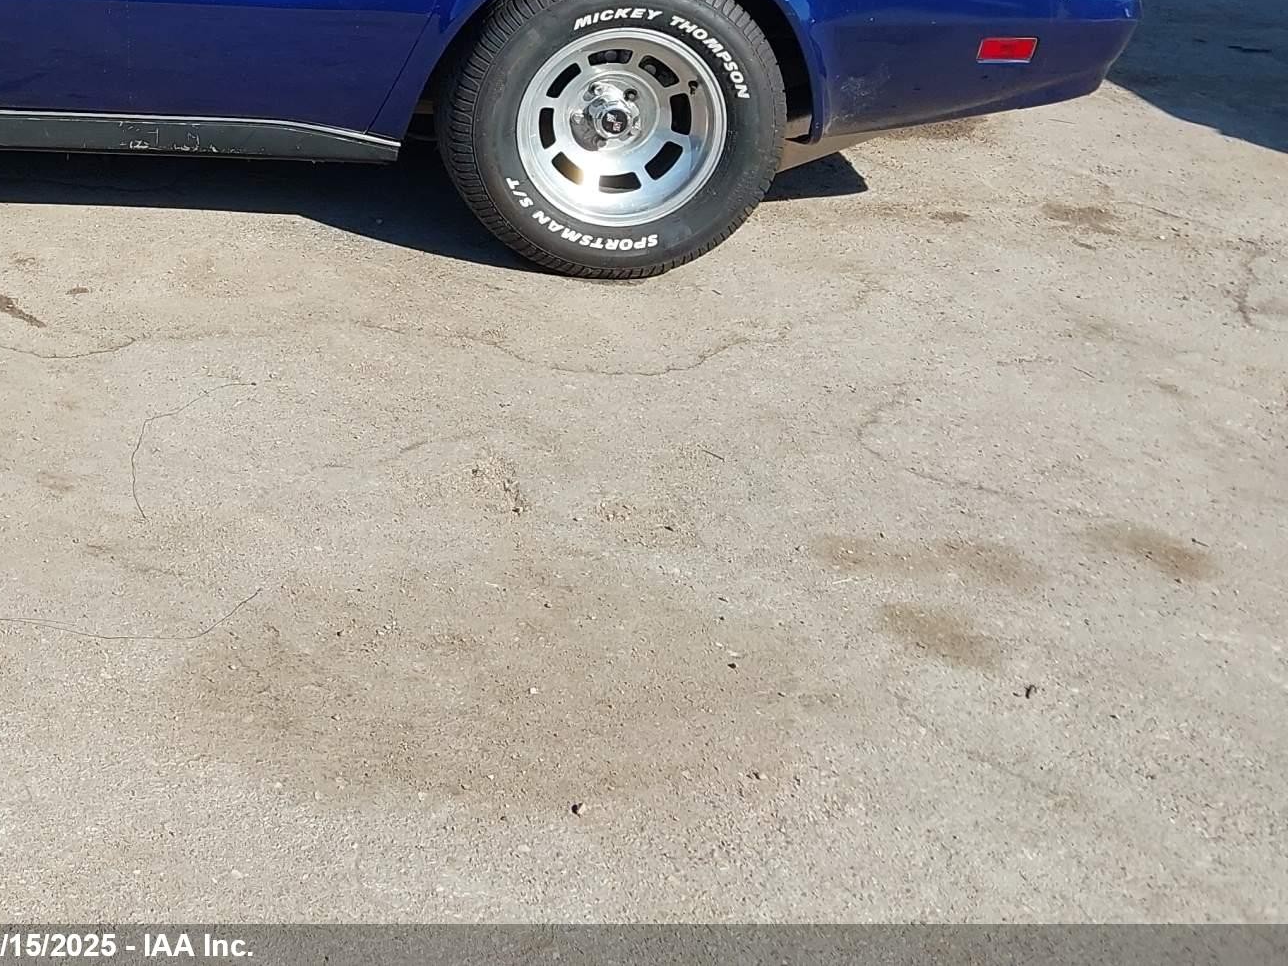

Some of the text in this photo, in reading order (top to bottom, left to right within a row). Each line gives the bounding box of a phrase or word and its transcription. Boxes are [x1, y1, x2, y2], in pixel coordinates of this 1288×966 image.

[573, 7, 751, 99] MICKEY THOMPSON
[506, 176, 659, 253] SPORTSMAN S/T
